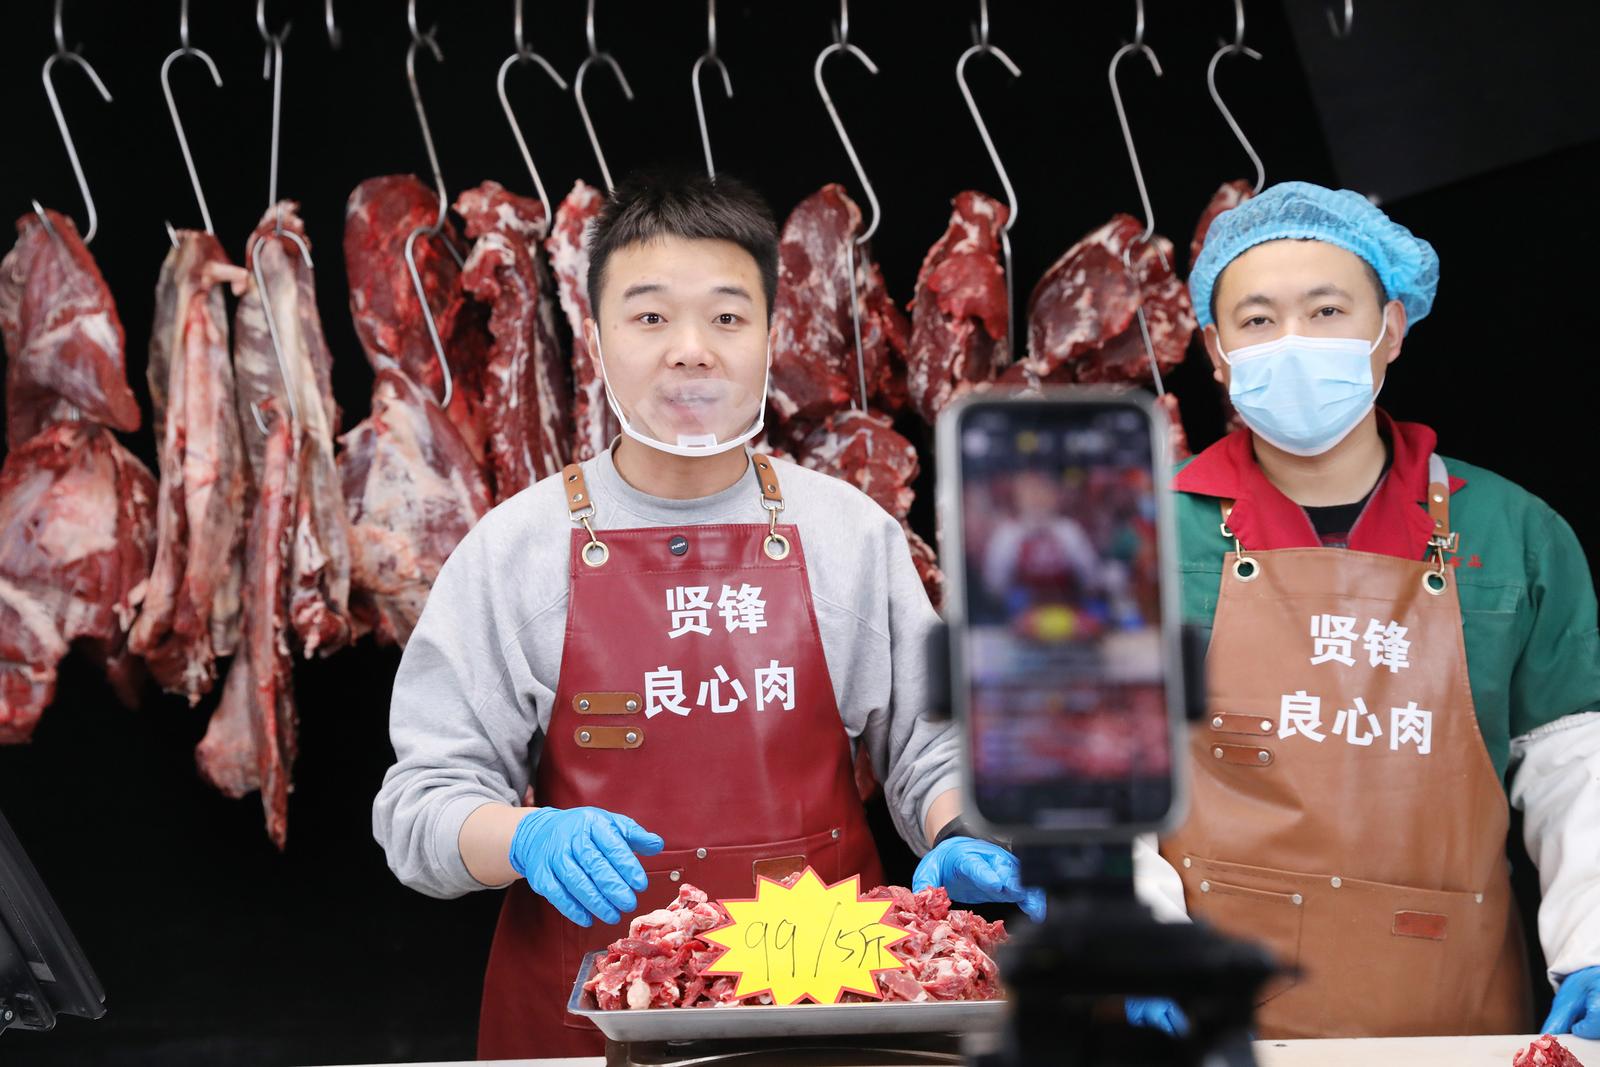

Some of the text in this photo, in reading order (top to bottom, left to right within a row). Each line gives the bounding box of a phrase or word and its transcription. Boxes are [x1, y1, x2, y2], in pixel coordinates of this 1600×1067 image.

[665, 583, 768, 639] 贤锋
[1309, 613, 1412, 673] 贤锋
[643, 659, 797, 720] 良心肉
[1277, 690, 1433, 755] 良心肉
